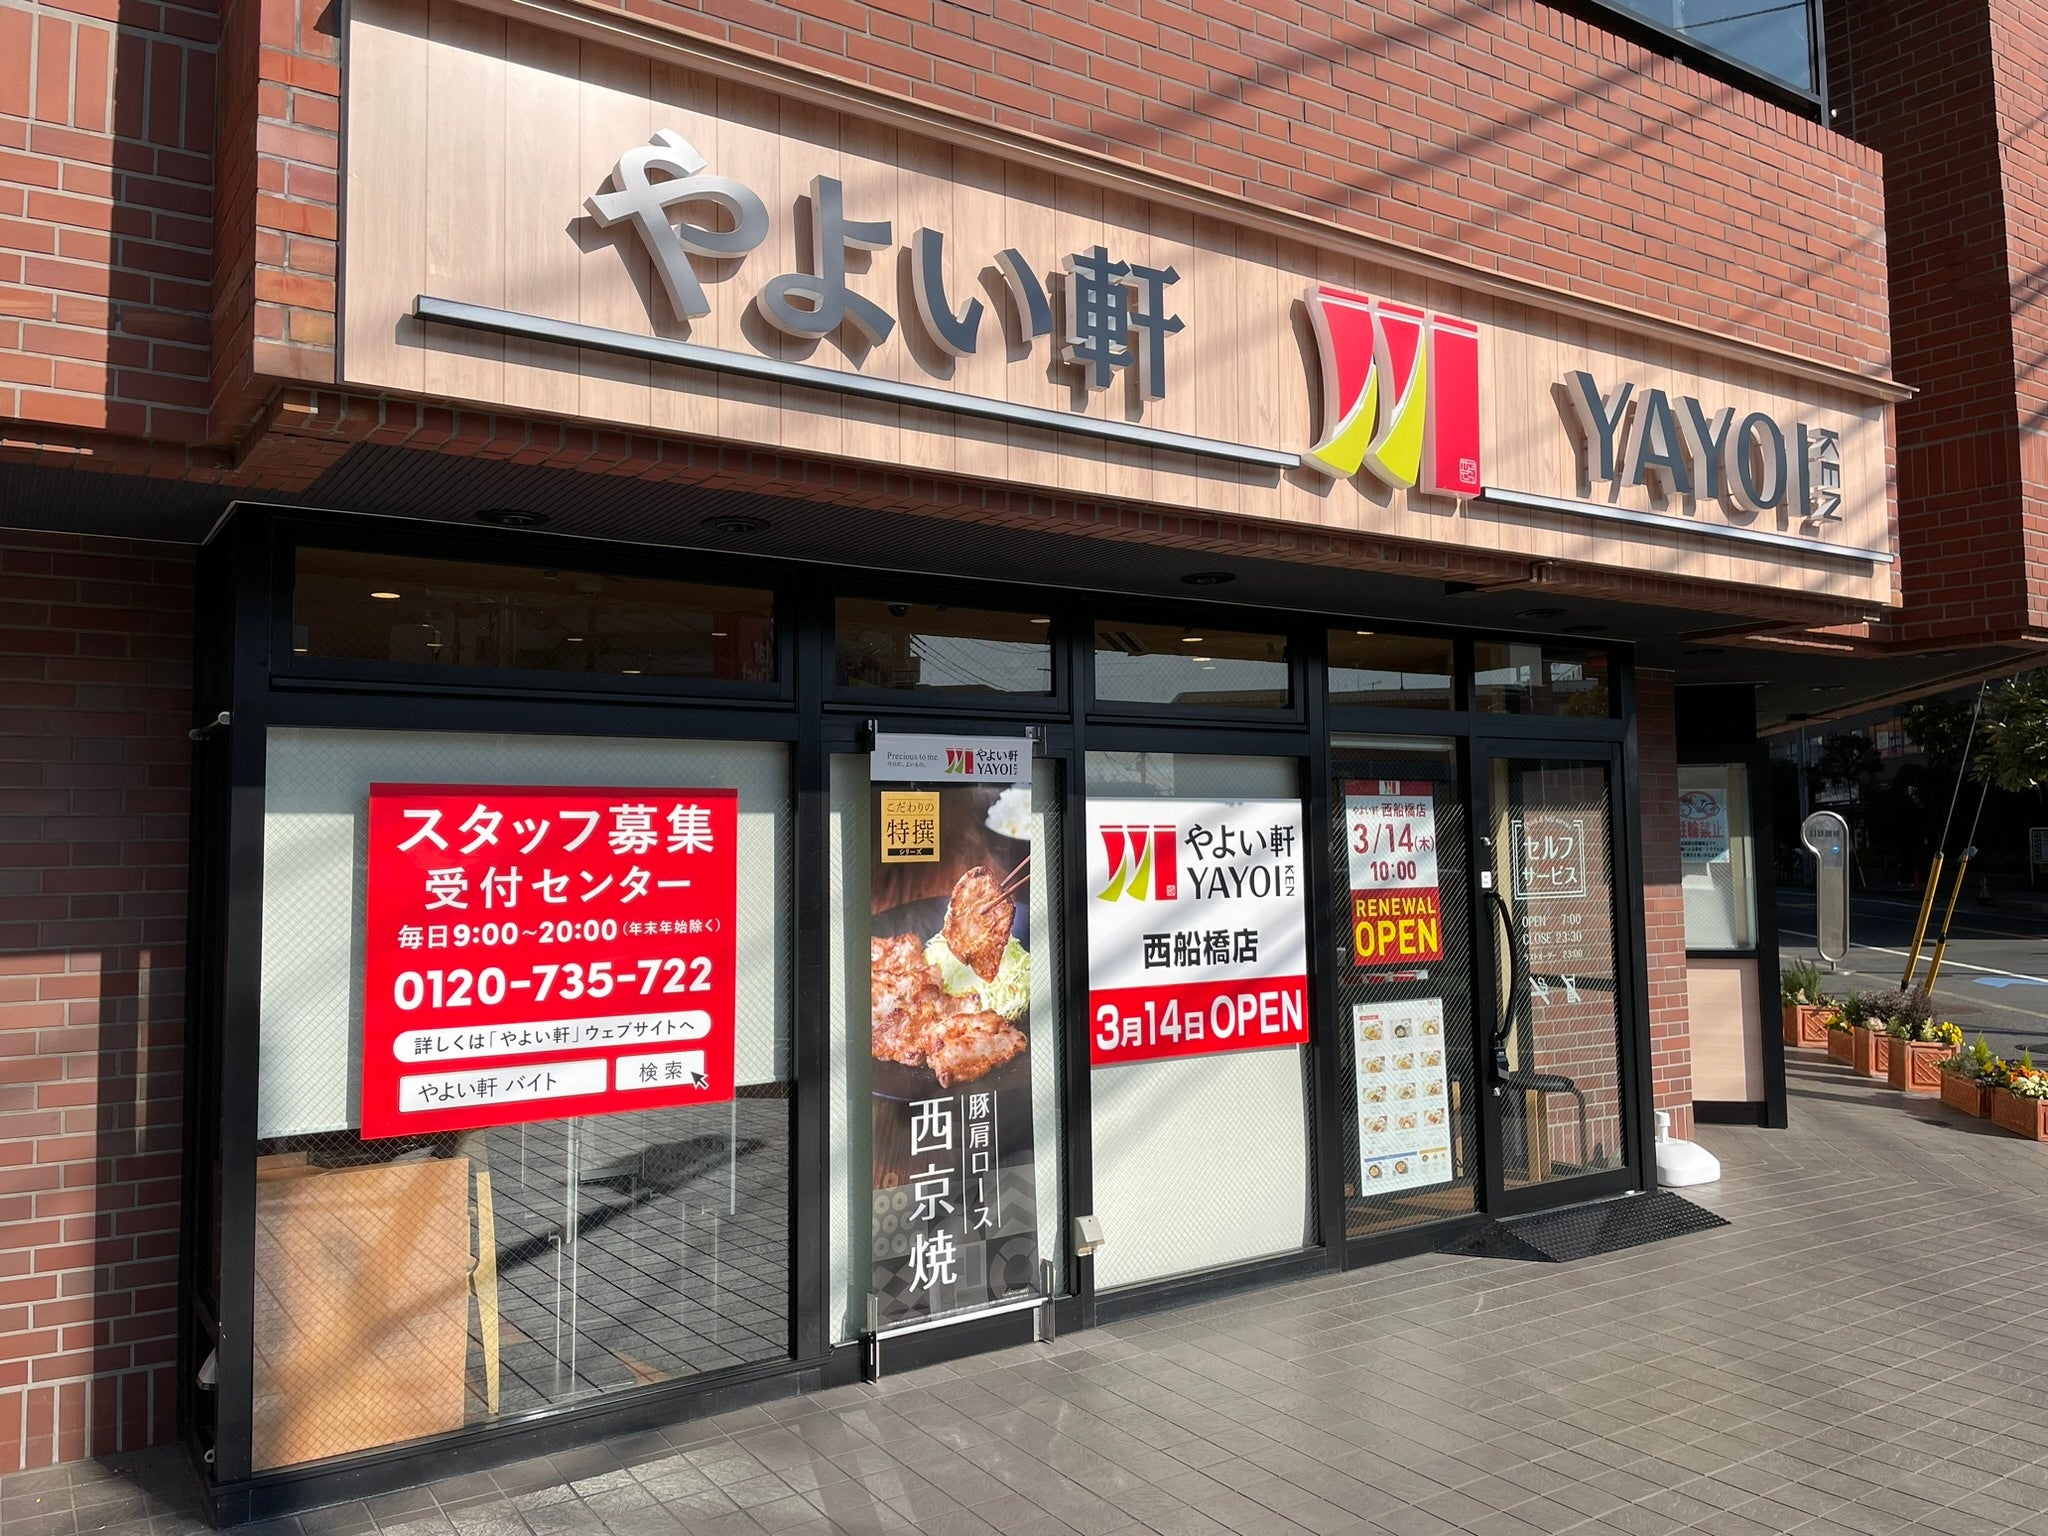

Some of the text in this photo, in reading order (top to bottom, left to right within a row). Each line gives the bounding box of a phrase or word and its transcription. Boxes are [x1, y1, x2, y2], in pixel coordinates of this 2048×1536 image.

[583, 128, 1186, 403] やよい軒
[1564, 369, 1842, 523] YAYOI KEN
[887, 751, 918, 761] Precious
[919, 752, 926, 761] to
[976, 749, 1018, 762] やよい軒
[977, 763, 1012, 775] YAYOI
[886, 801, 935, 814] こだわりの
[1381, 802, 1427, 818] 西船橋店
[397, 803, 715, 856] スタッフ募集
[886, 819, 935, 845] 特撰
[1184, 823, 1295, 860] やよい軒
[1523, 835, 1574, 860] セルフ
[1187, 864, 1296, 899] YAYOI KEN
[1370, 860, 1417, 881] 10:00
[1521, 865, 1578, 887] サービス
[425, 865, 691, 910] 受付センター
[1355, 896, 1437, 917] RENEWAL
[1522, 913, 1582, 928] OPEN 7:00
[1143, 927, 1259, 969] 西船橋店
[1355, 917, 1438, 958] OPEN
[1522, 930, 1583, 946] CLOSE 23:30
[393, 956, 714, 1011] 0120-735-722
[1096, 989, 1303, 1051] 3月14日 OPEN
[414, 1018, 696, 1056] 詳しくは「やよい軒」ウェブサイトへ
[418, 1071, 558, 1104] やよい軒 バイト
[638, 1060, 683, 1083] 検索
[968, 1092, 993, 1231] 豚肩ロース
[908, 1096, 958, 1293] 西京焼
